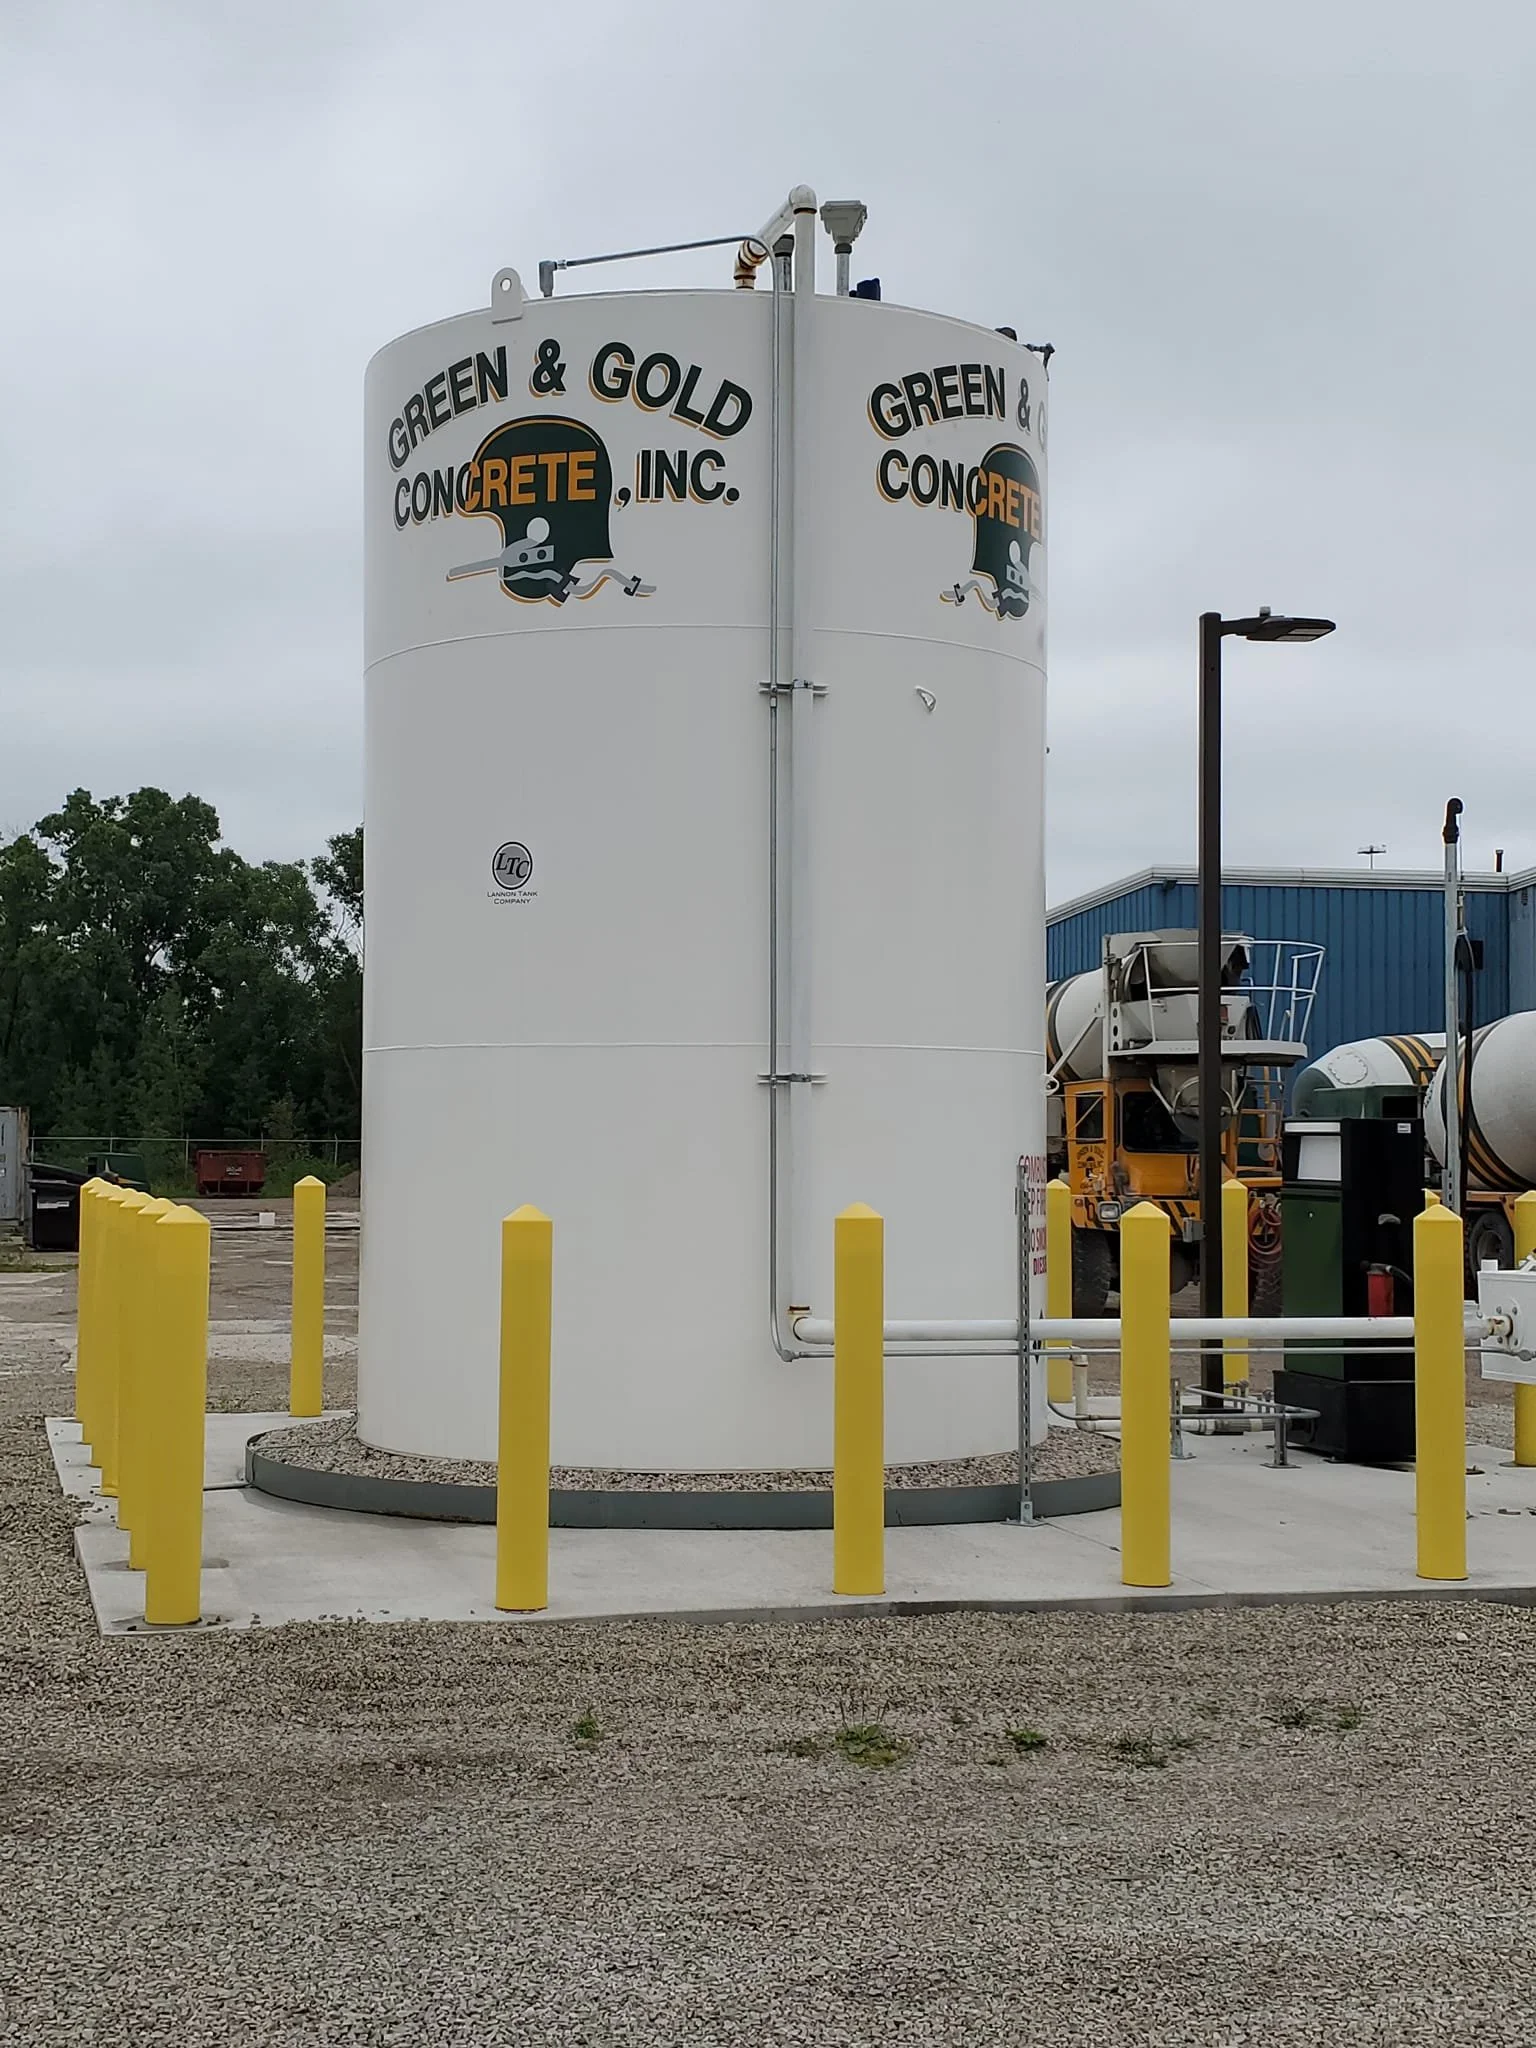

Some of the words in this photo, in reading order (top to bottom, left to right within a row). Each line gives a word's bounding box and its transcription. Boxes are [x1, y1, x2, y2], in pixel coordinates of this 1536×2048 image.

[387, 345, 509, 469] GREEN
[530, 338, 567, 396] &
[589, 341, 753, 439] GOLD
[867, 363, 1006, 441] GREEN
[1016, 377, 1032, 434] &
[393, 449, 597, 530] CONCRETE
[876, 448, 1043, 541] CONCRETE
[495, 852, 530, 879] LTC
